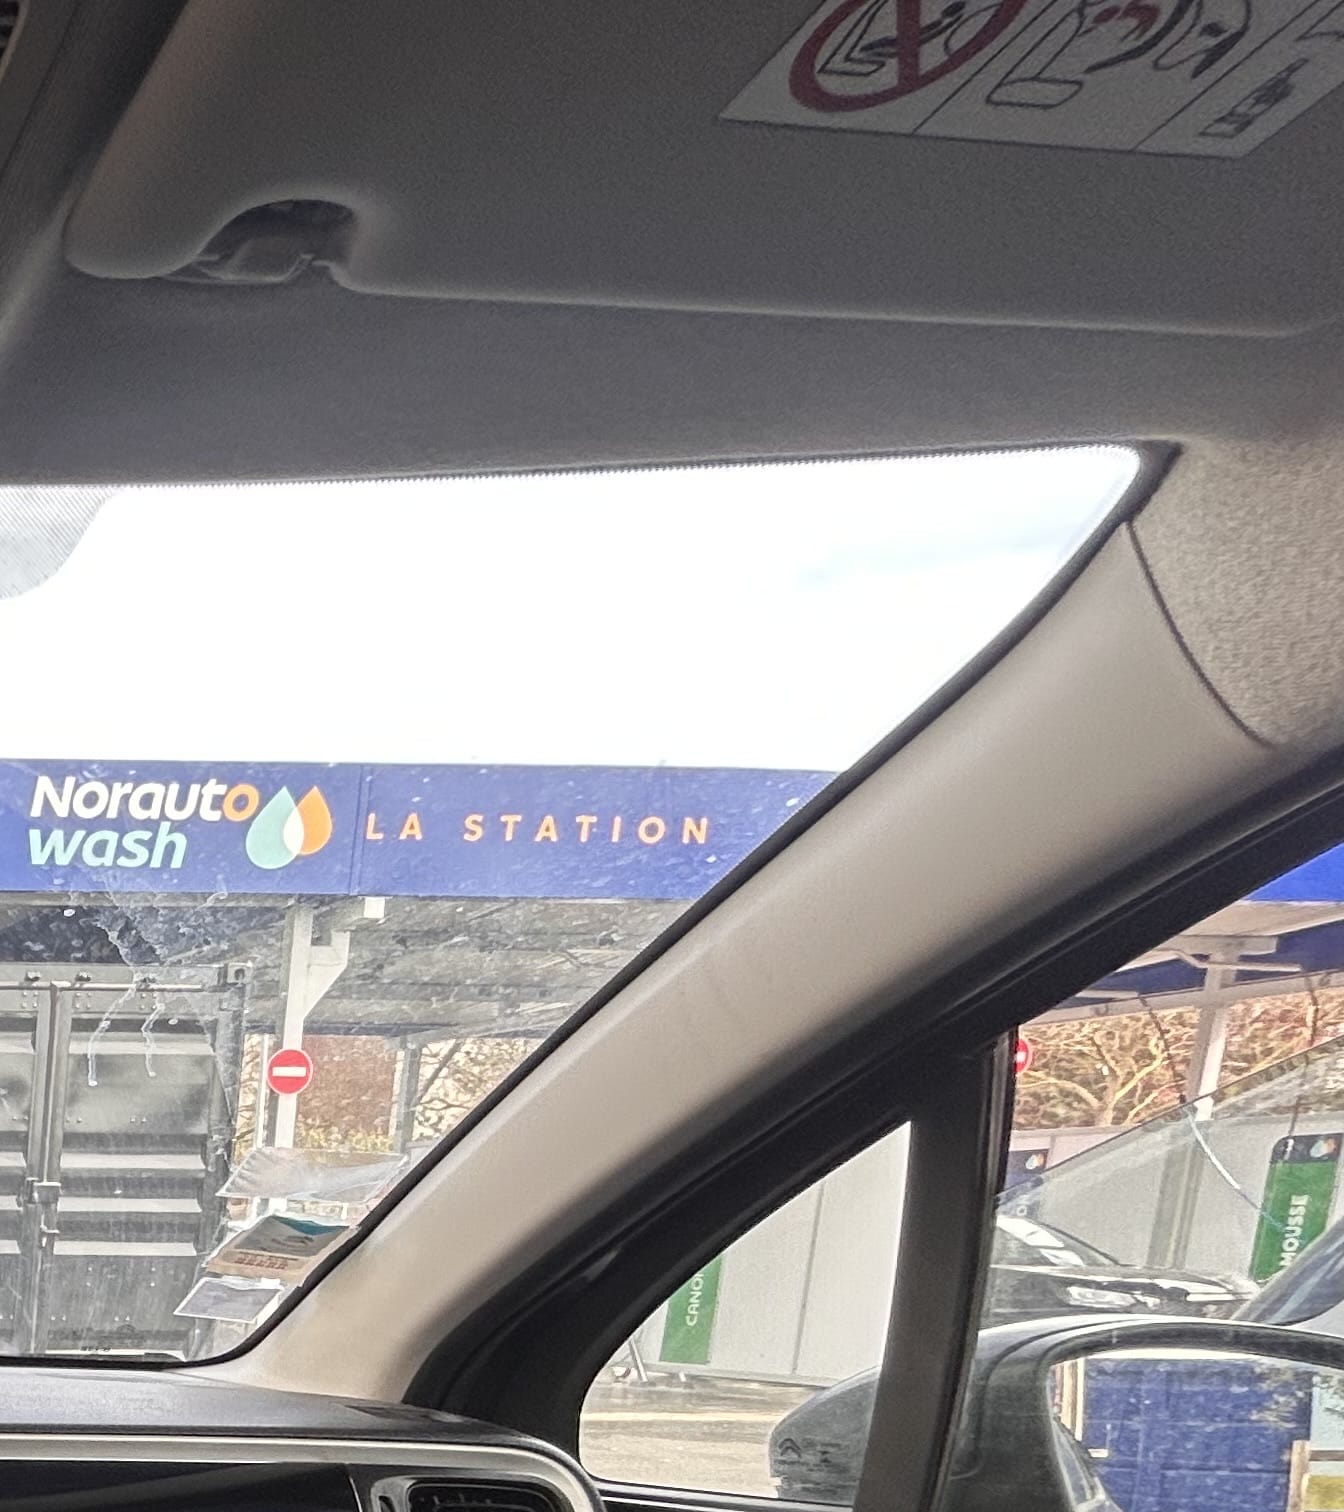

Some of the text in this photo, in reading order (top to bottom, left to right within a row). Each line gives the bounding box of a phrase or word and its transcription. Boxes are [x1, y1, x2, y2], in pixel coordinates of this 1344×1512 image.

[29, 774, 260, 822] Norauto
[28, 820, 188, 869] wash
[365, 812, 709, 845] LA STATION
[1278, 1194, 1312, 1267] MOUSSE
[685, 1273, 705, 1327] CANO
